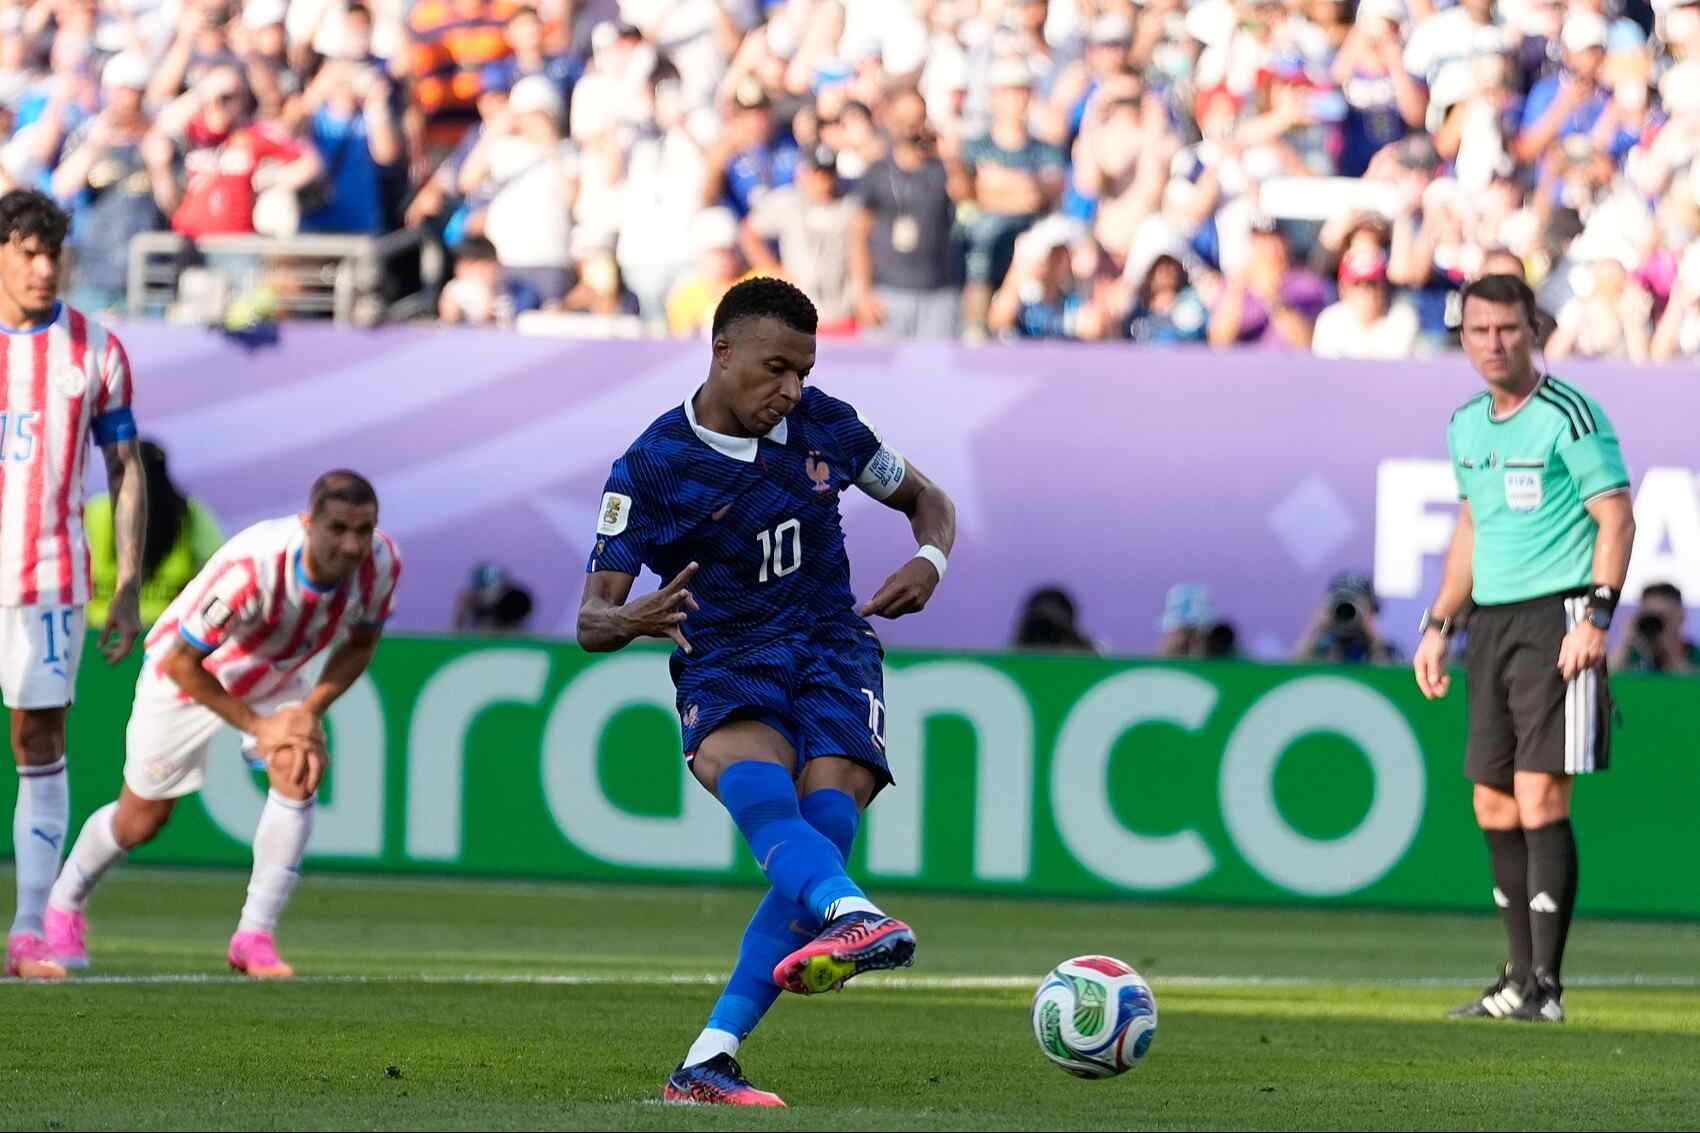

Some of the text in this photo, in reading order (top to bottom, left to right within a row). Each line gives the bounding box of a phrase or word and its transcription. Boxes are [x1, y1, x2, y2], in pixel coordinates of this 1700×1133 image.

[0, 411, 38, 463] 15
[756, 518, 801, 583] 10
[861, 687, 886, 752] 10
